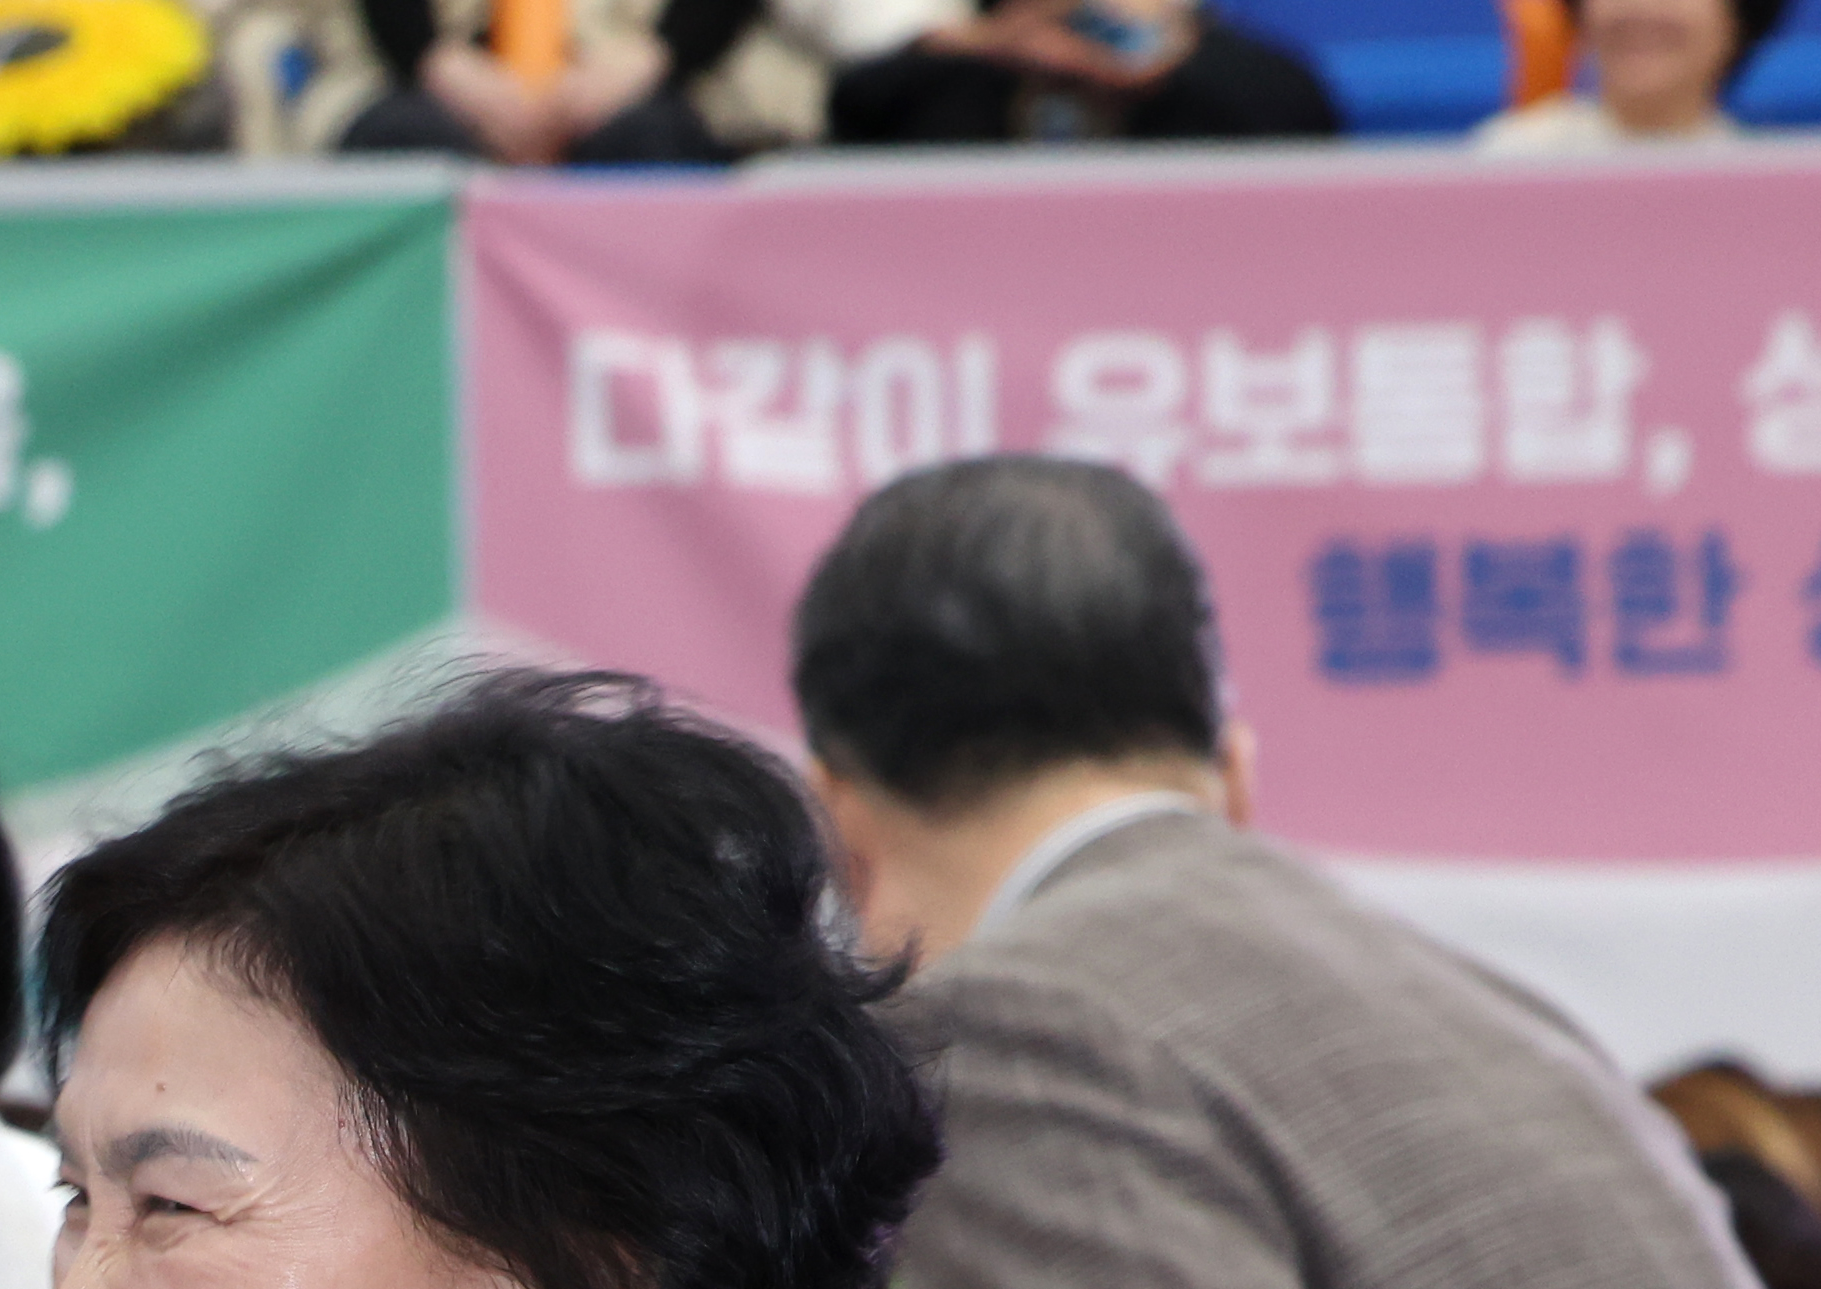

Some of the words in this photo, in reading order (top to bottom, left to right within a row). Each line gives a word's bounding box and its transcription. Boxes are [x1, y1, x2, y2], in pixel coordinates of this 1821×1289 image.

[569, 328, 997, 494] 다같이
[1045, 318, 1695, 497] 유보통합,
[1307, 524, 1743, 686] 행복한
